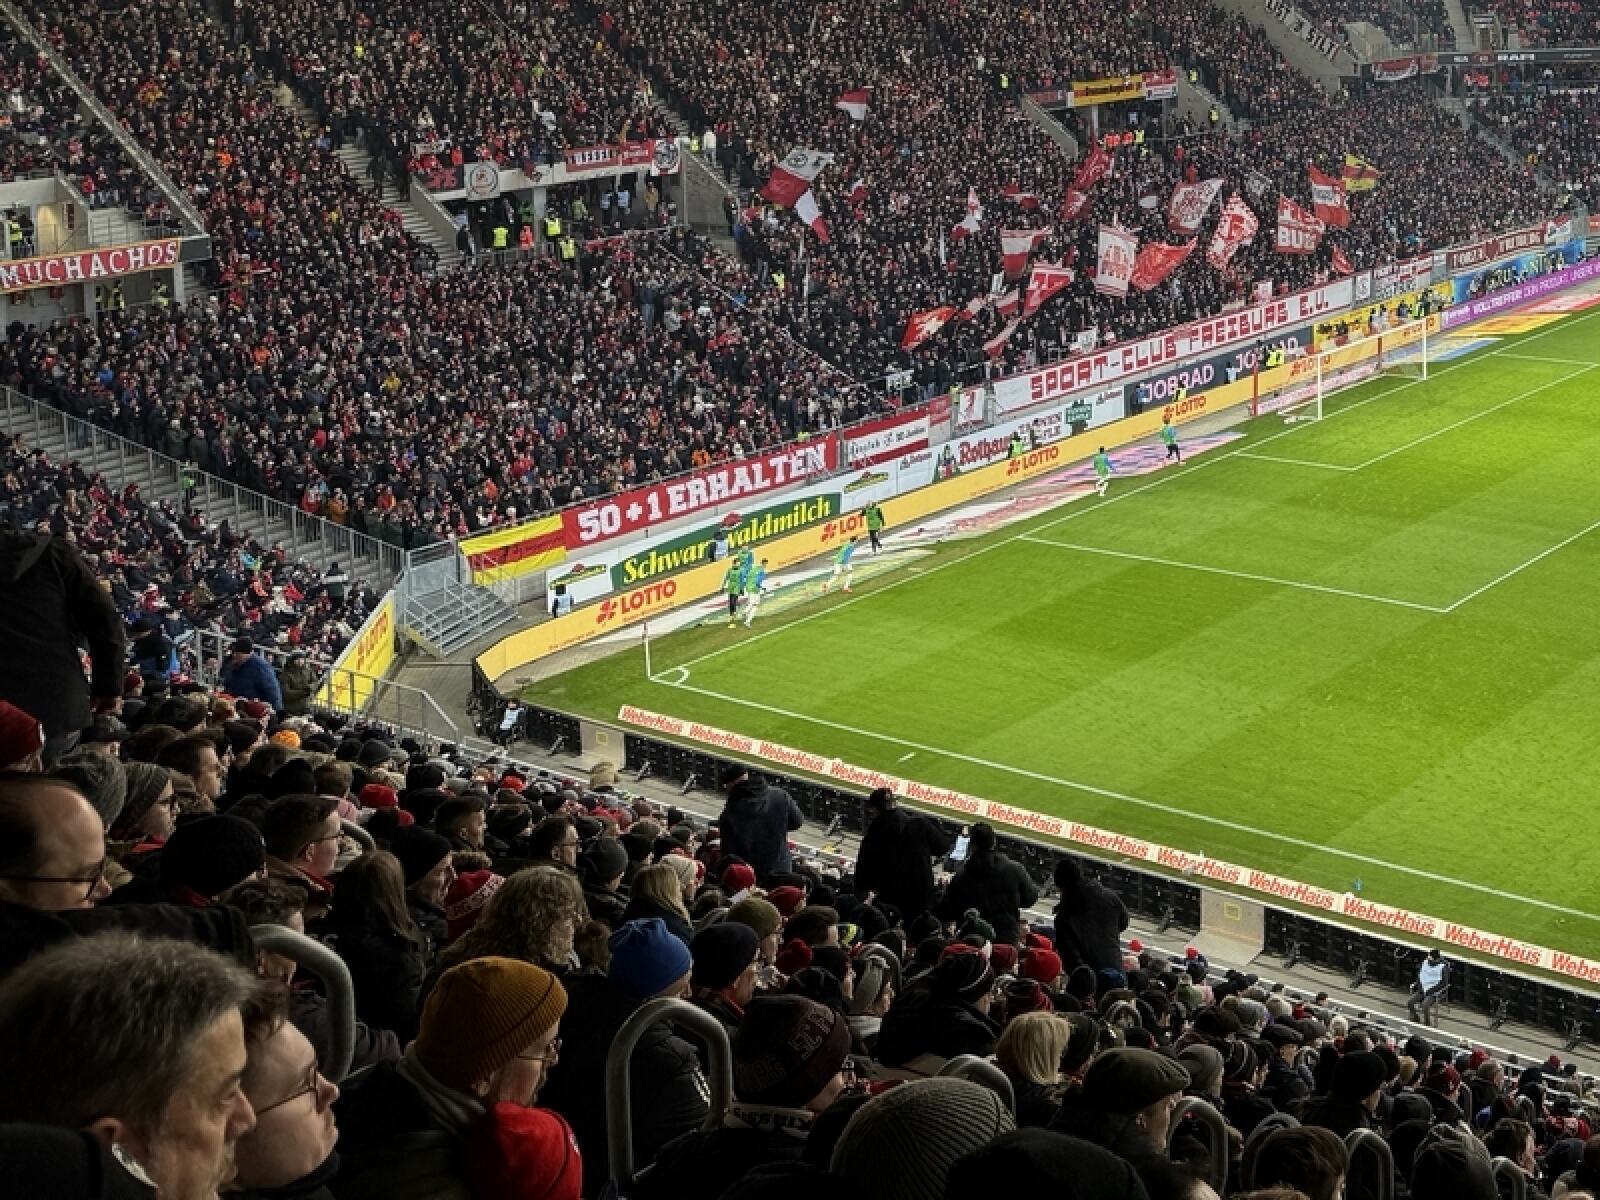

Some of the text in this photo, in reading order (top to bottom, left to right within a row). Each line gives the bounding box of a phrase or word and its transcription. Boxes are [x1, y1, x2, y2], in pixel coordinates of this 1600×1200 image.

[1176, 395, 1207, 416] LOTTO
[959, 432, 1012, 467] Rothau
[1022, 445, 1059, 469] LOTTO
[666, 442, 827, 515] ERHALTEN
[623, 494, 831, 584] Schwarwaldmilch
[620, 579, 677, 615] LOTTO
[831, 760, 899, 791] WeberHaus
[906, 782, 980, 813] WeberHaus
[986, 803, 1063, 836] WeberHaus
[1070, 823, 1149, 858] WeberHaus
[1156, 846, 1240, 884] WeberHaus
[1248, 871, 1334, 910] WeberHaus
[1343, 897, 1436, 937] WeberHaus
[1445, 923, 1541, 965] WeberHaus
